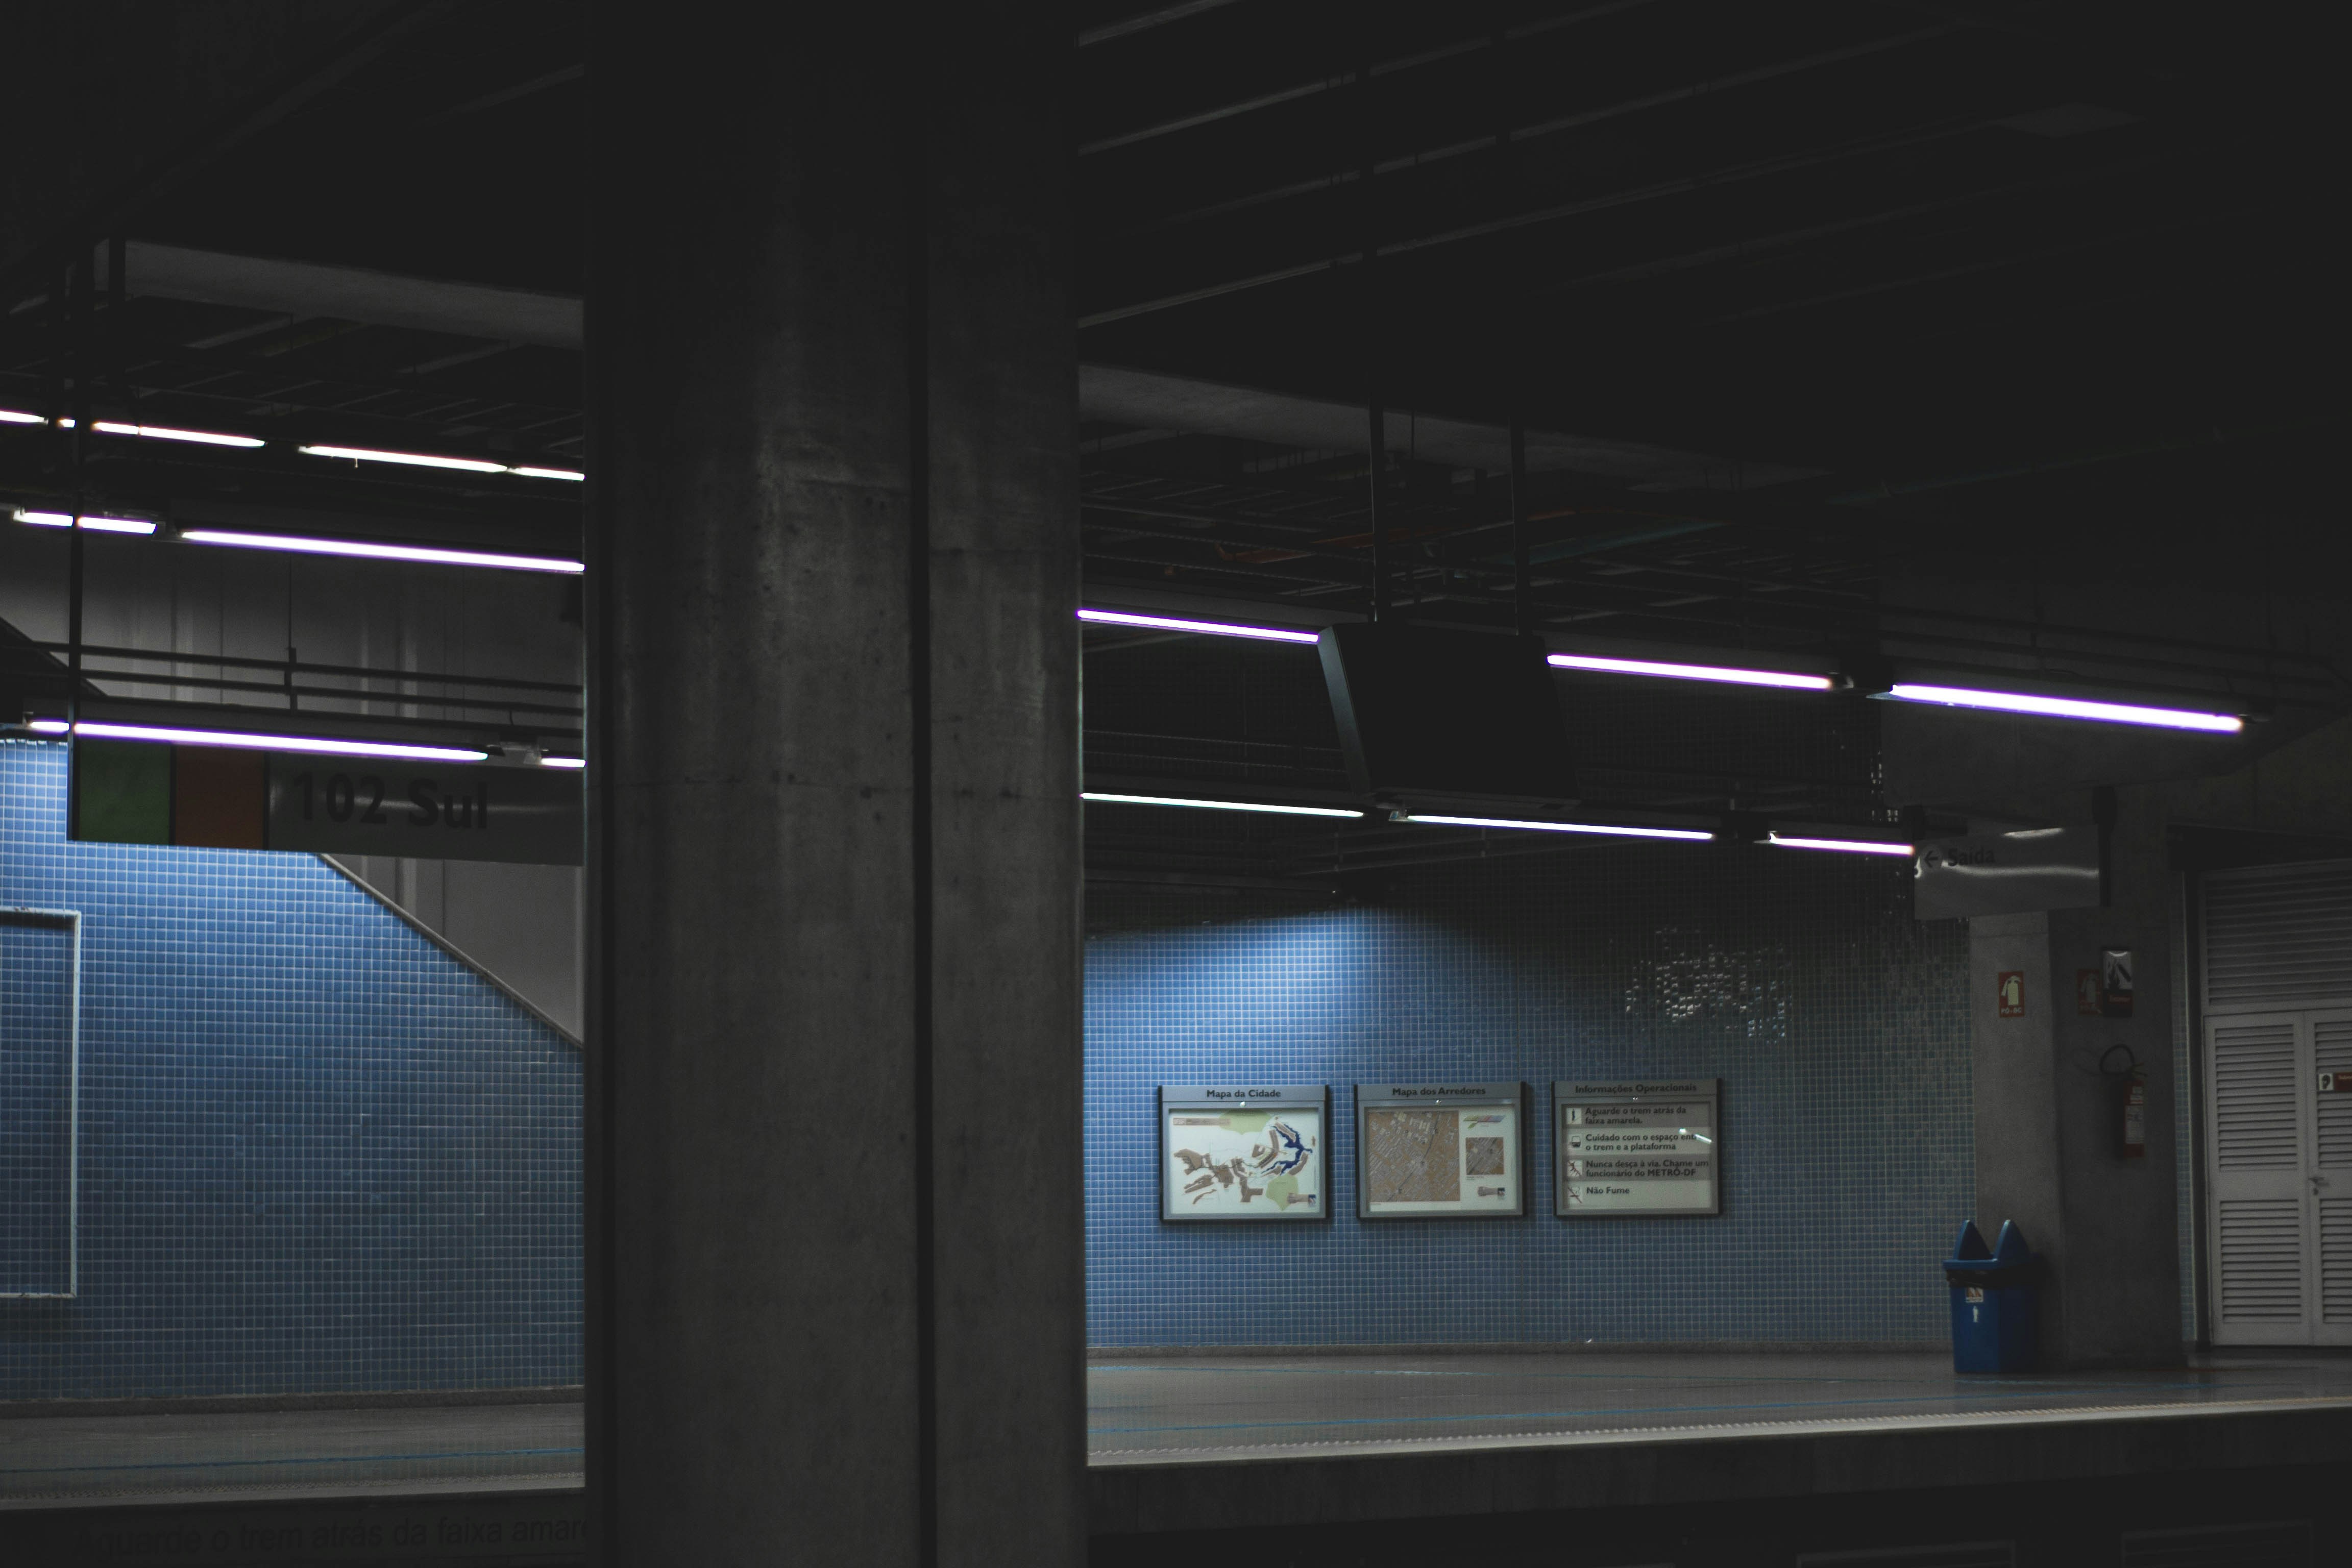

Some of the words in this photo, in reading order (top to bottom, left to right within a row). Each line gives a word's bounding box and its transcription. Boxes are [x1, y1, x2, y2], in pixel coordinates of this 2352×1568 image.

[294, 771, 387, 824] 102
[408, 777, 487, 829] Sul
[1947, 847, 1996, 866] Saída
[1207, 1090, 1231, 1099] Mapa
[1248, 1089, 1281, 1097] Cidade
[1392, 1088, 1417, 1097] Mapa
[1438, 1087, 1486, 1095] Arredores
[1575, 1084, 1632, 1095] Informações
[1635, 1084, 1697, 1093] Operacionais
[1585, 1108, 1620, 1116] Aguarde
[1650, 1135, 1678, 1143] espaço
[1631, 1143, 1676, 1152] plataforma
[1615, 1160, 1637, 1169] desça
[1586, 1169, 1632, 1177] funcionário
[74, 1524, 202, 1563] Aguarde
[210, 1531, 230, 1552] o
[241, 1524, 303, 1552] trem
[312, 1518, 383, 1549] atrás
[394, 1518, 428, 1545] da
[438, 1516, 503, 1544] faixa
